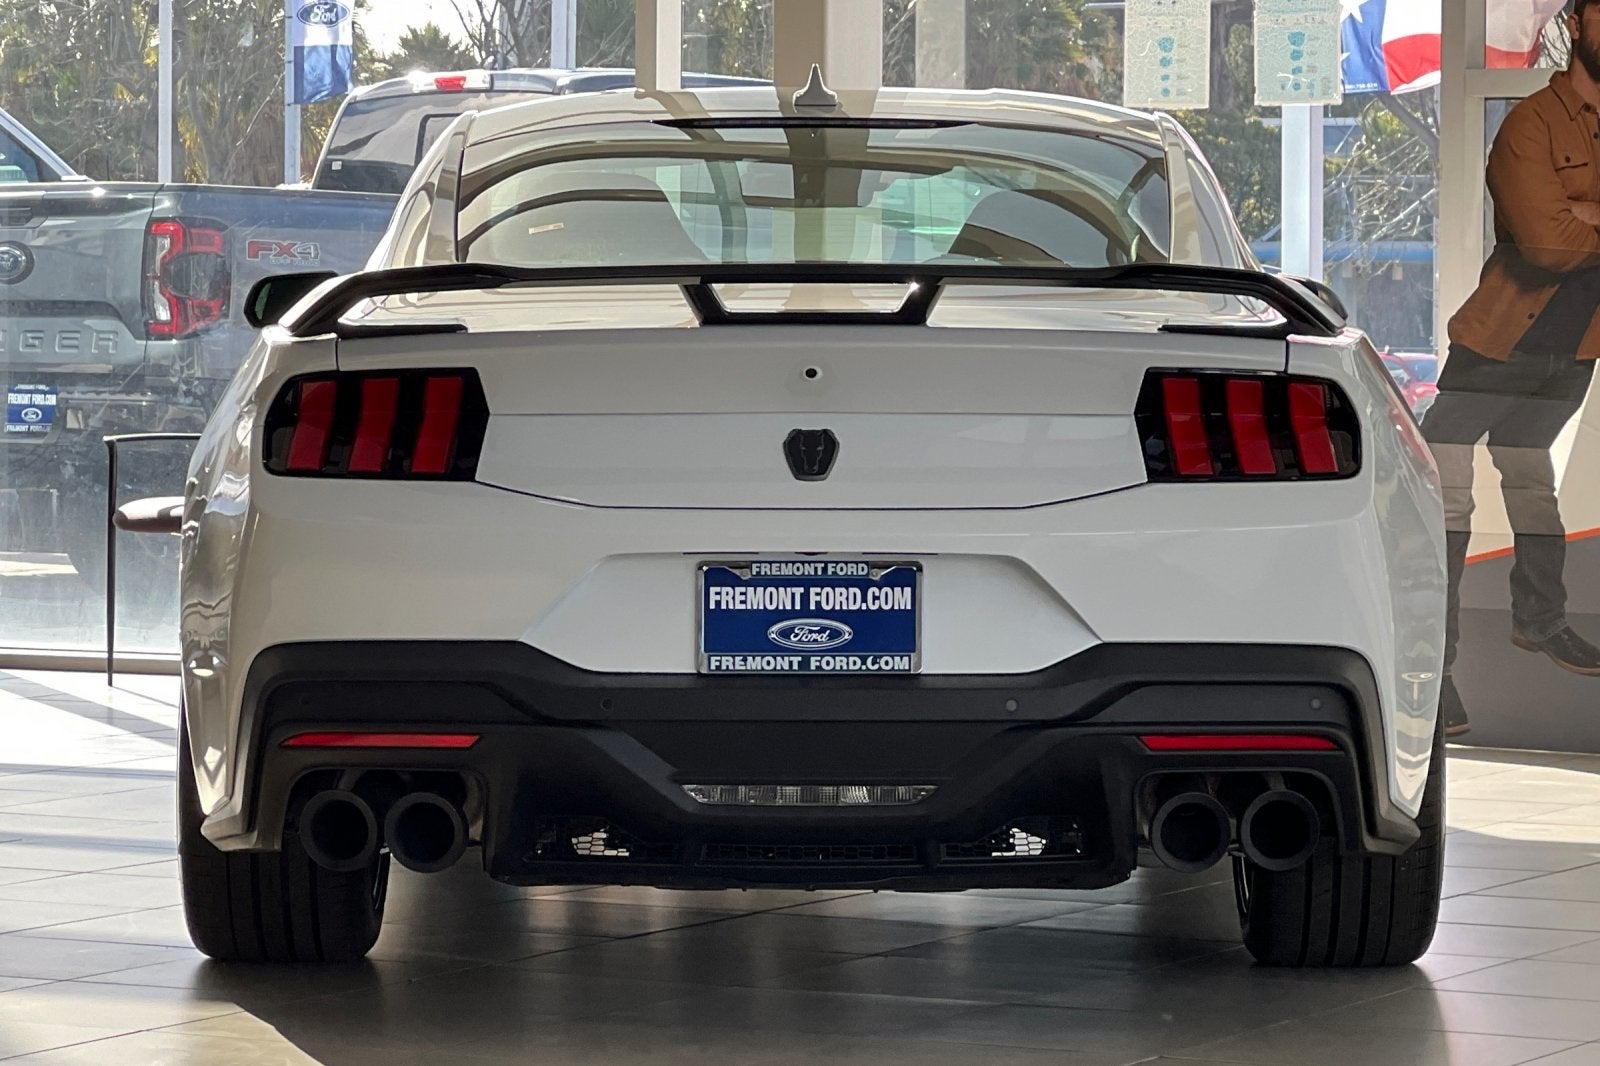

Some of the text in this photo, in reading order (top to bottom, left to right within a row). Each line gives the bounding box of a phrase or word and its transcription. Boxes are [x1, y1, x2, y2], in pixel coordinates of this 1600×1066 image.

[310, 5, 337, 22] Ford
[246, 239, 321, 260] FX4
[751, 562, 869, 577] FREMONT FORD
[709, 586, 912, 610] FREMONT FORD.COM
[789, 625, 831, 642] Ford
[709, 655, 910, 671] FREMONT FORD.COM
